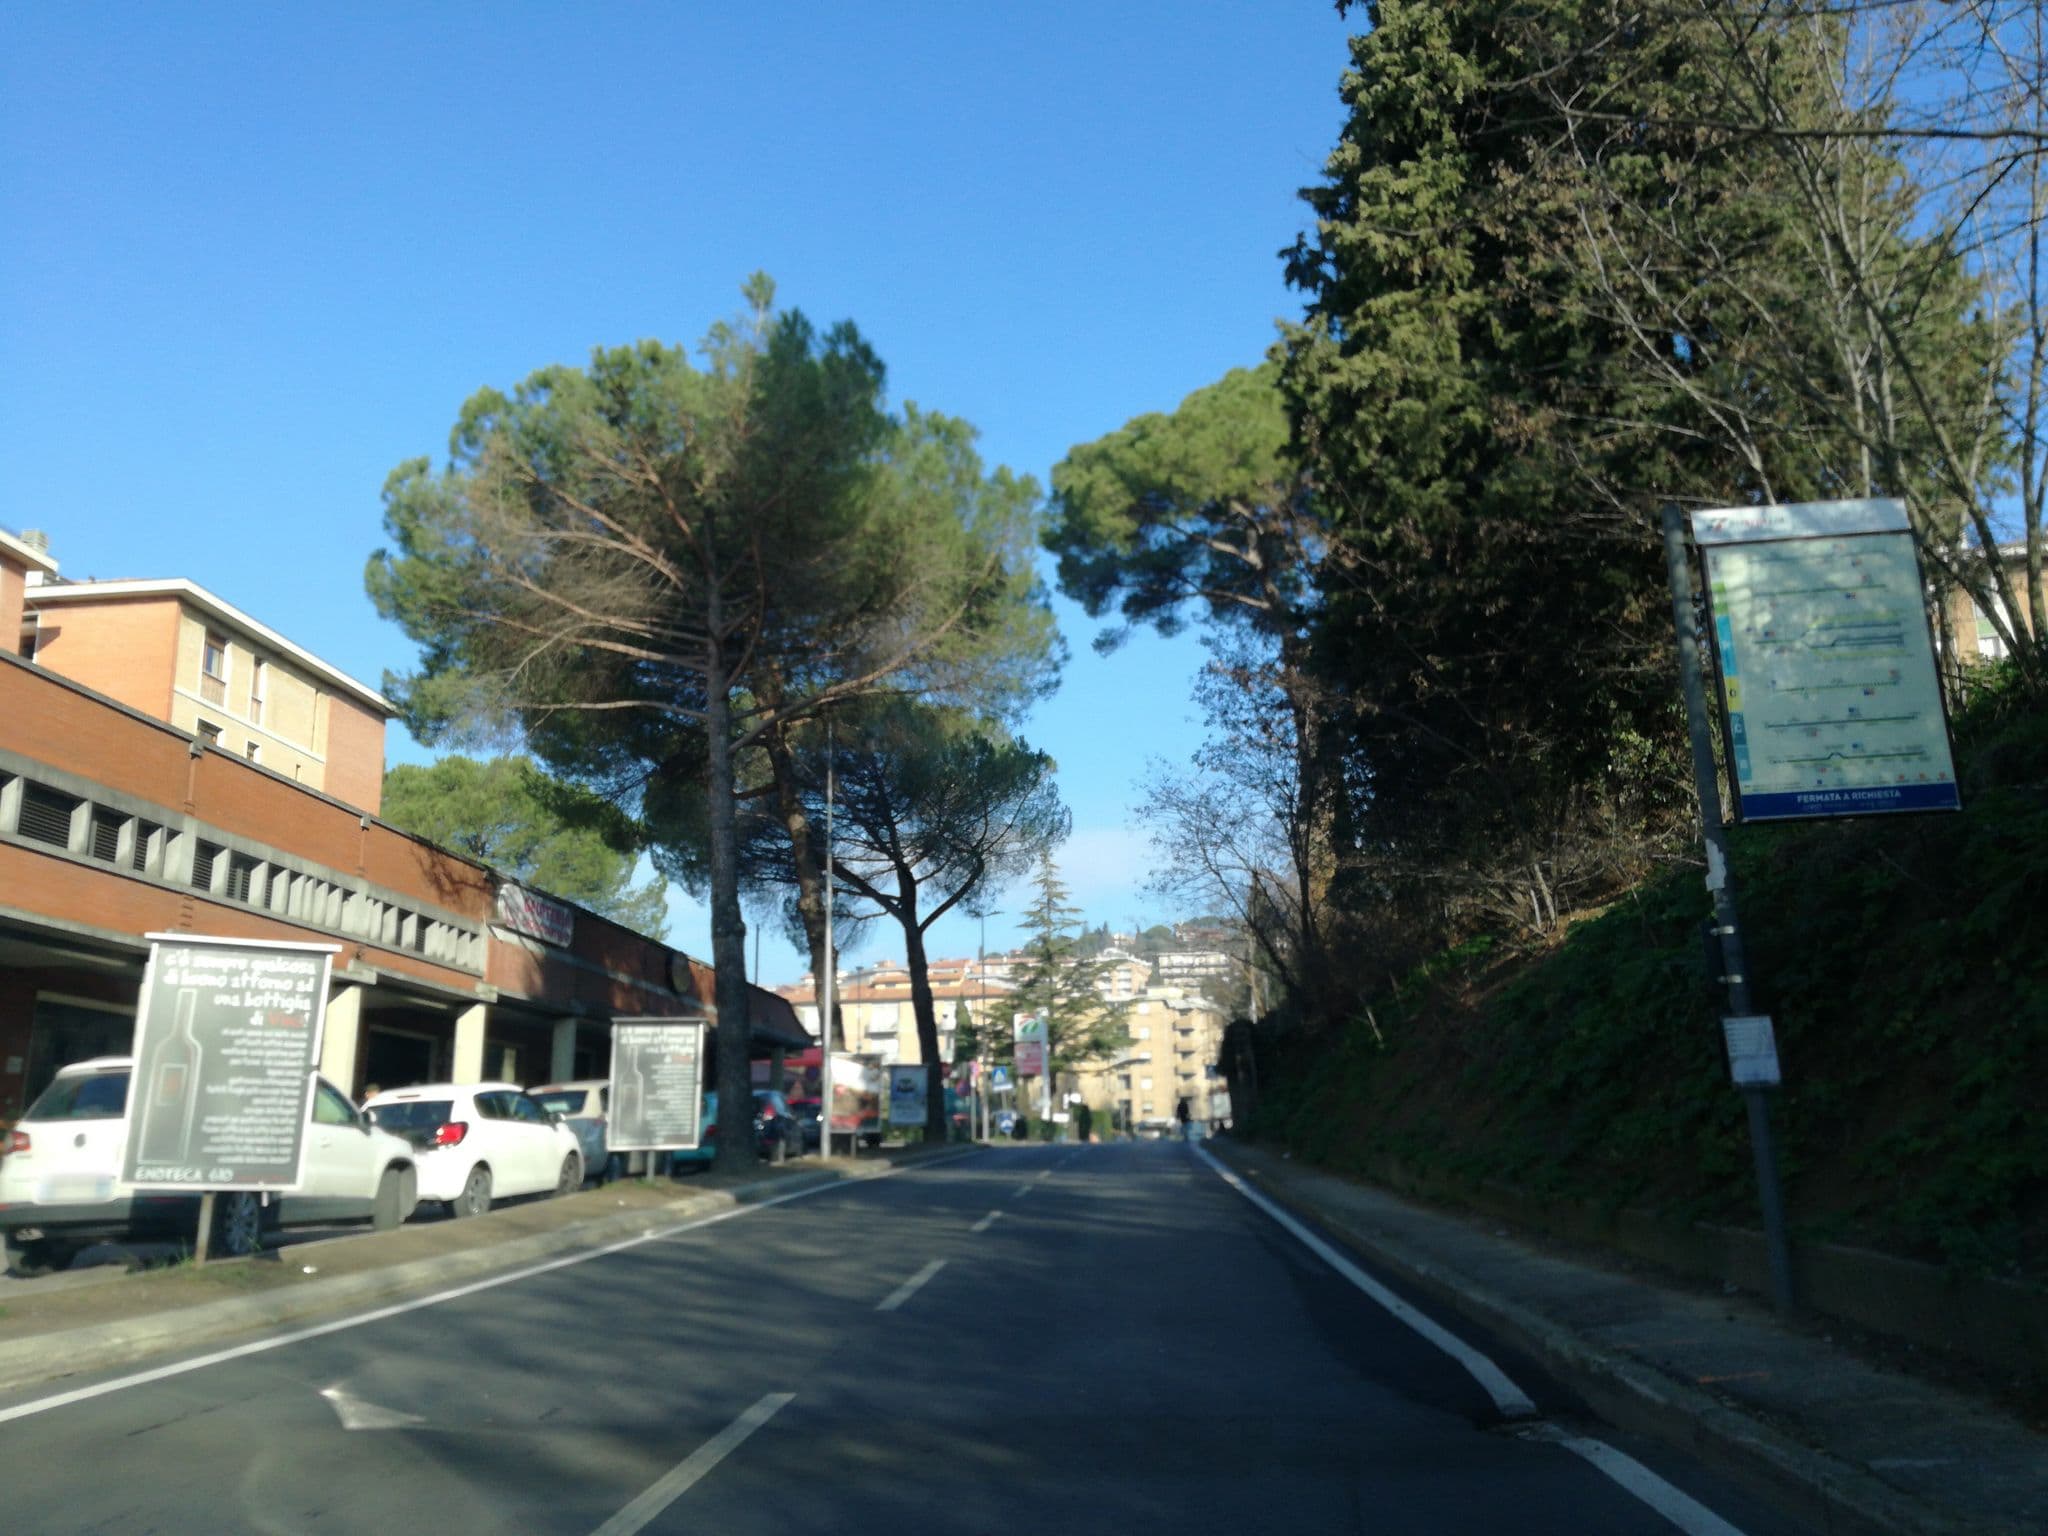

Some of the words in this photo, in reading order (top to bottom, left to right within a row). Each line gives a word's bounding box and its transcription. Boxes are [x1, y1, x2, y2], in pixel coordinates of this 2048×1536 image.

[1797, 792, 1841, 803] FERMATA
[1843, 793, 1850, 801] A
[1851, 790, 1901, 800] RICHIESTA
[214, 993, 240, 1006] una
[244, 992, 311, 1014] bottiglia
[250, 1010, 263, 1026] di
[135, 1168, 202, 1182] ENOTECA
